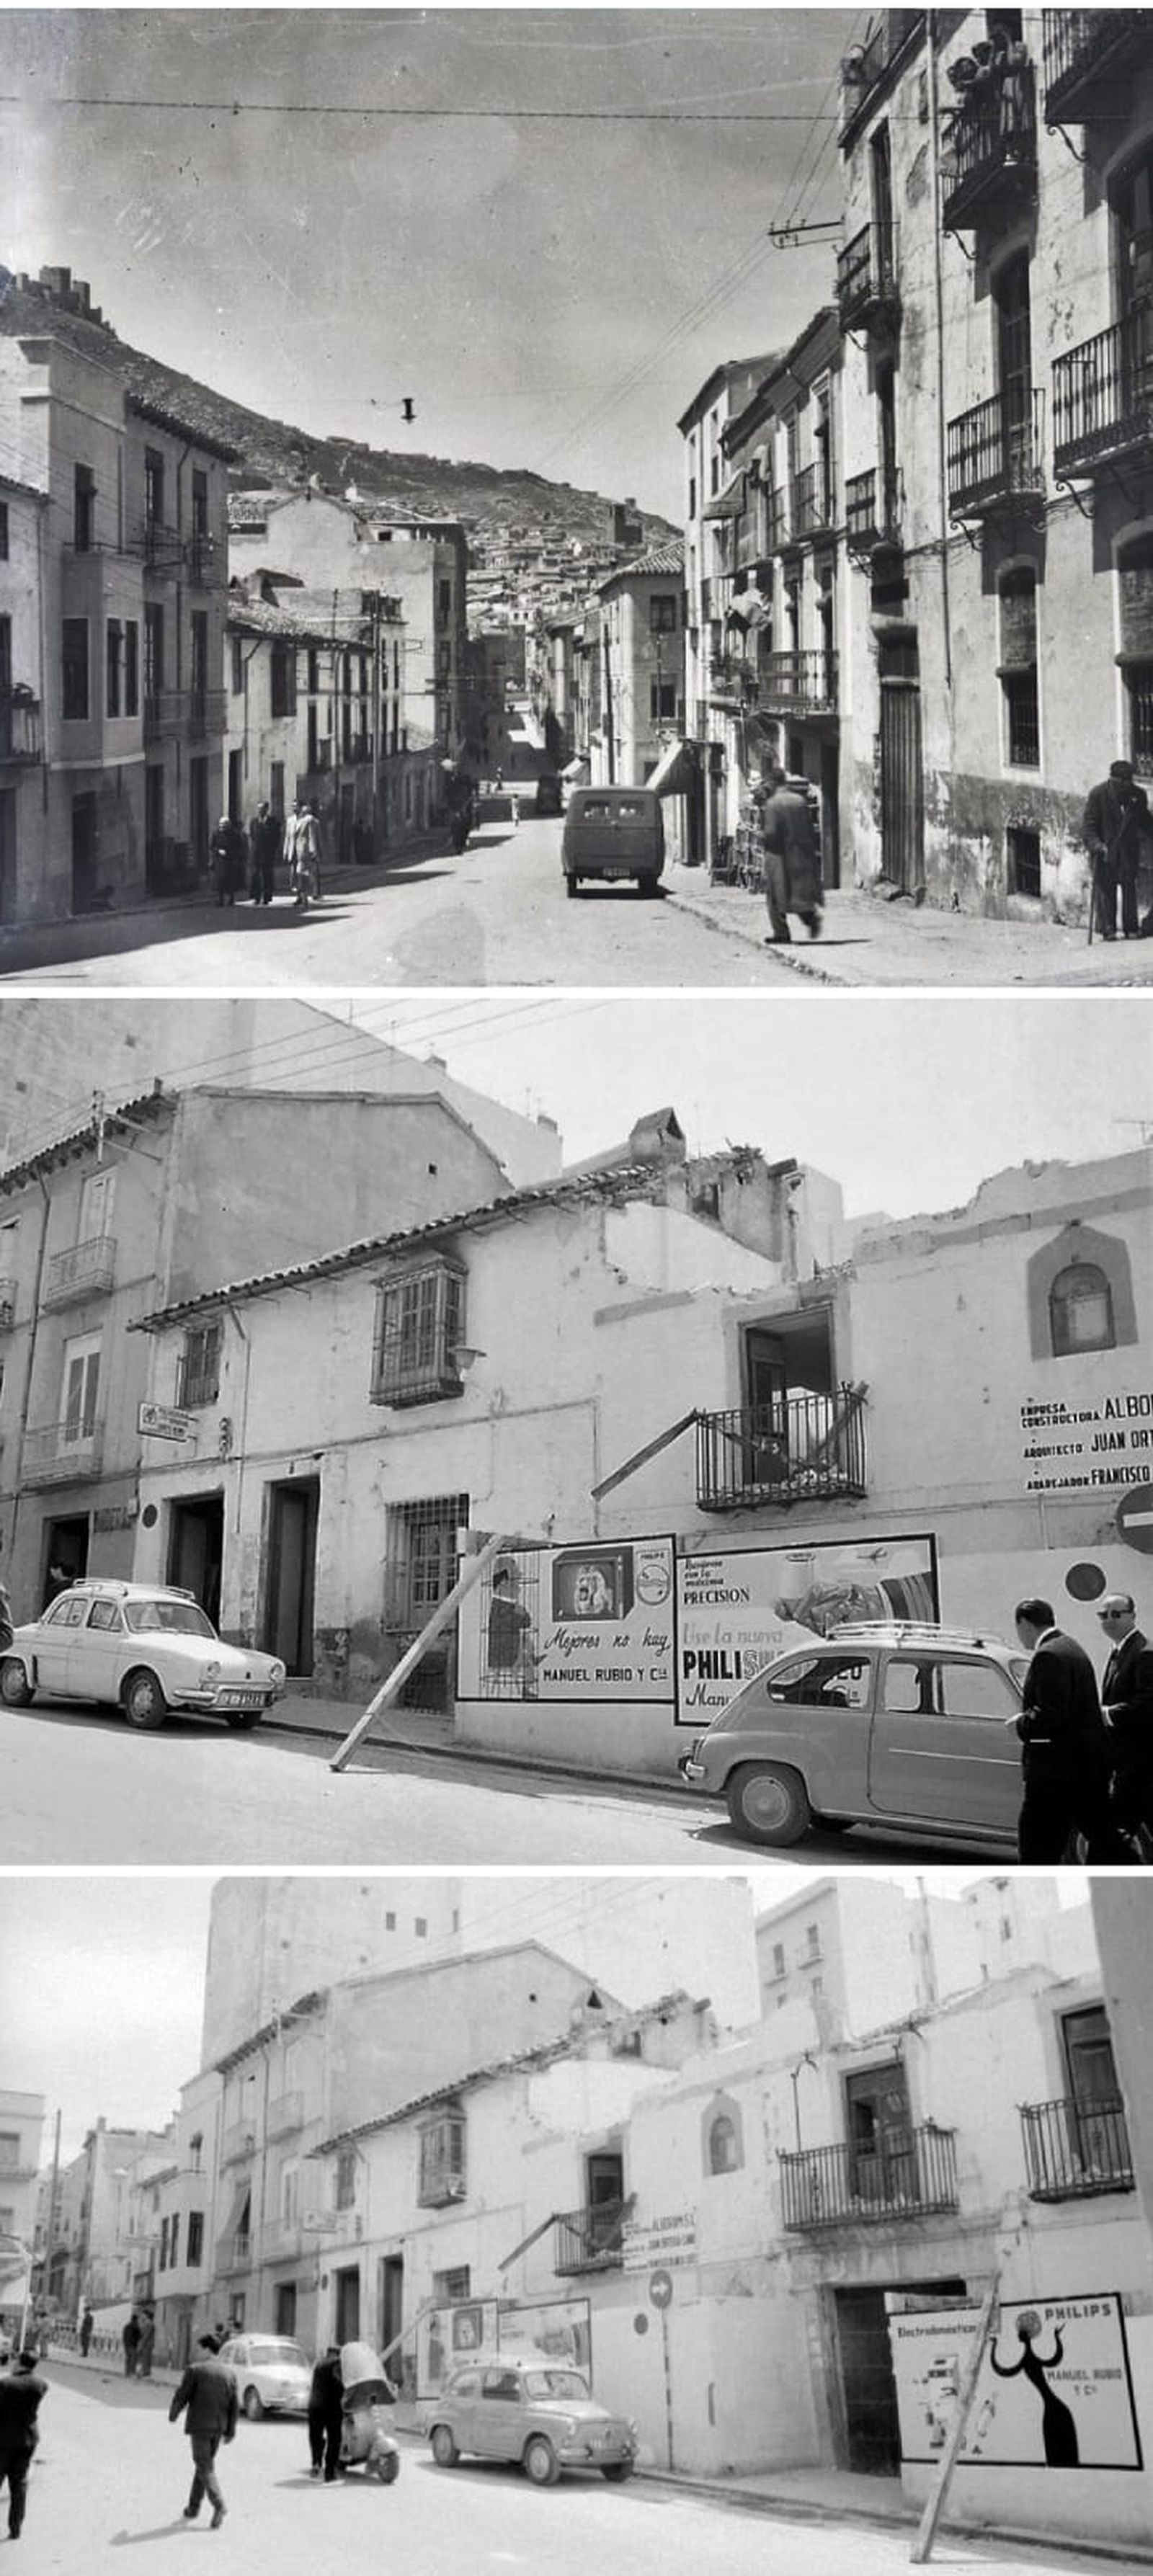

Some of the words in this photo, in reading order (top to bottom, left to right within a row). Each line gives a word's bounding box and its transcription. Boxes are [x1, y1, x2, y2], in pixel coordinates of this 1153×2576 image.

[1020, 1403, 1067, 1417] EMPRESA
[1022, 1411, 1101, 1428] CONSTRUCTORA
[1105, 1394, 1153, 1420] ALBO
[1023, 1443, 1083, 1458] ARQUITECTO
[1091, 1431, 1126, 1452] JUAN
[1091, 1465, 1151, 1486] FRANCISCO
[684, 1587, 750, 1605] PRECISION
[543, 1627, 600, 1658] Mejores
[613, 1634, 631, 1648] no
[715, 1622, 732, 1644] la
[543, 1668, 591, 1682] MANUEL
[595, 1668, 633, 1682] RUBIO
[637, 1668, 645, 1682] Y
[1045, 2304, 1110, 2320] PHILIPS
